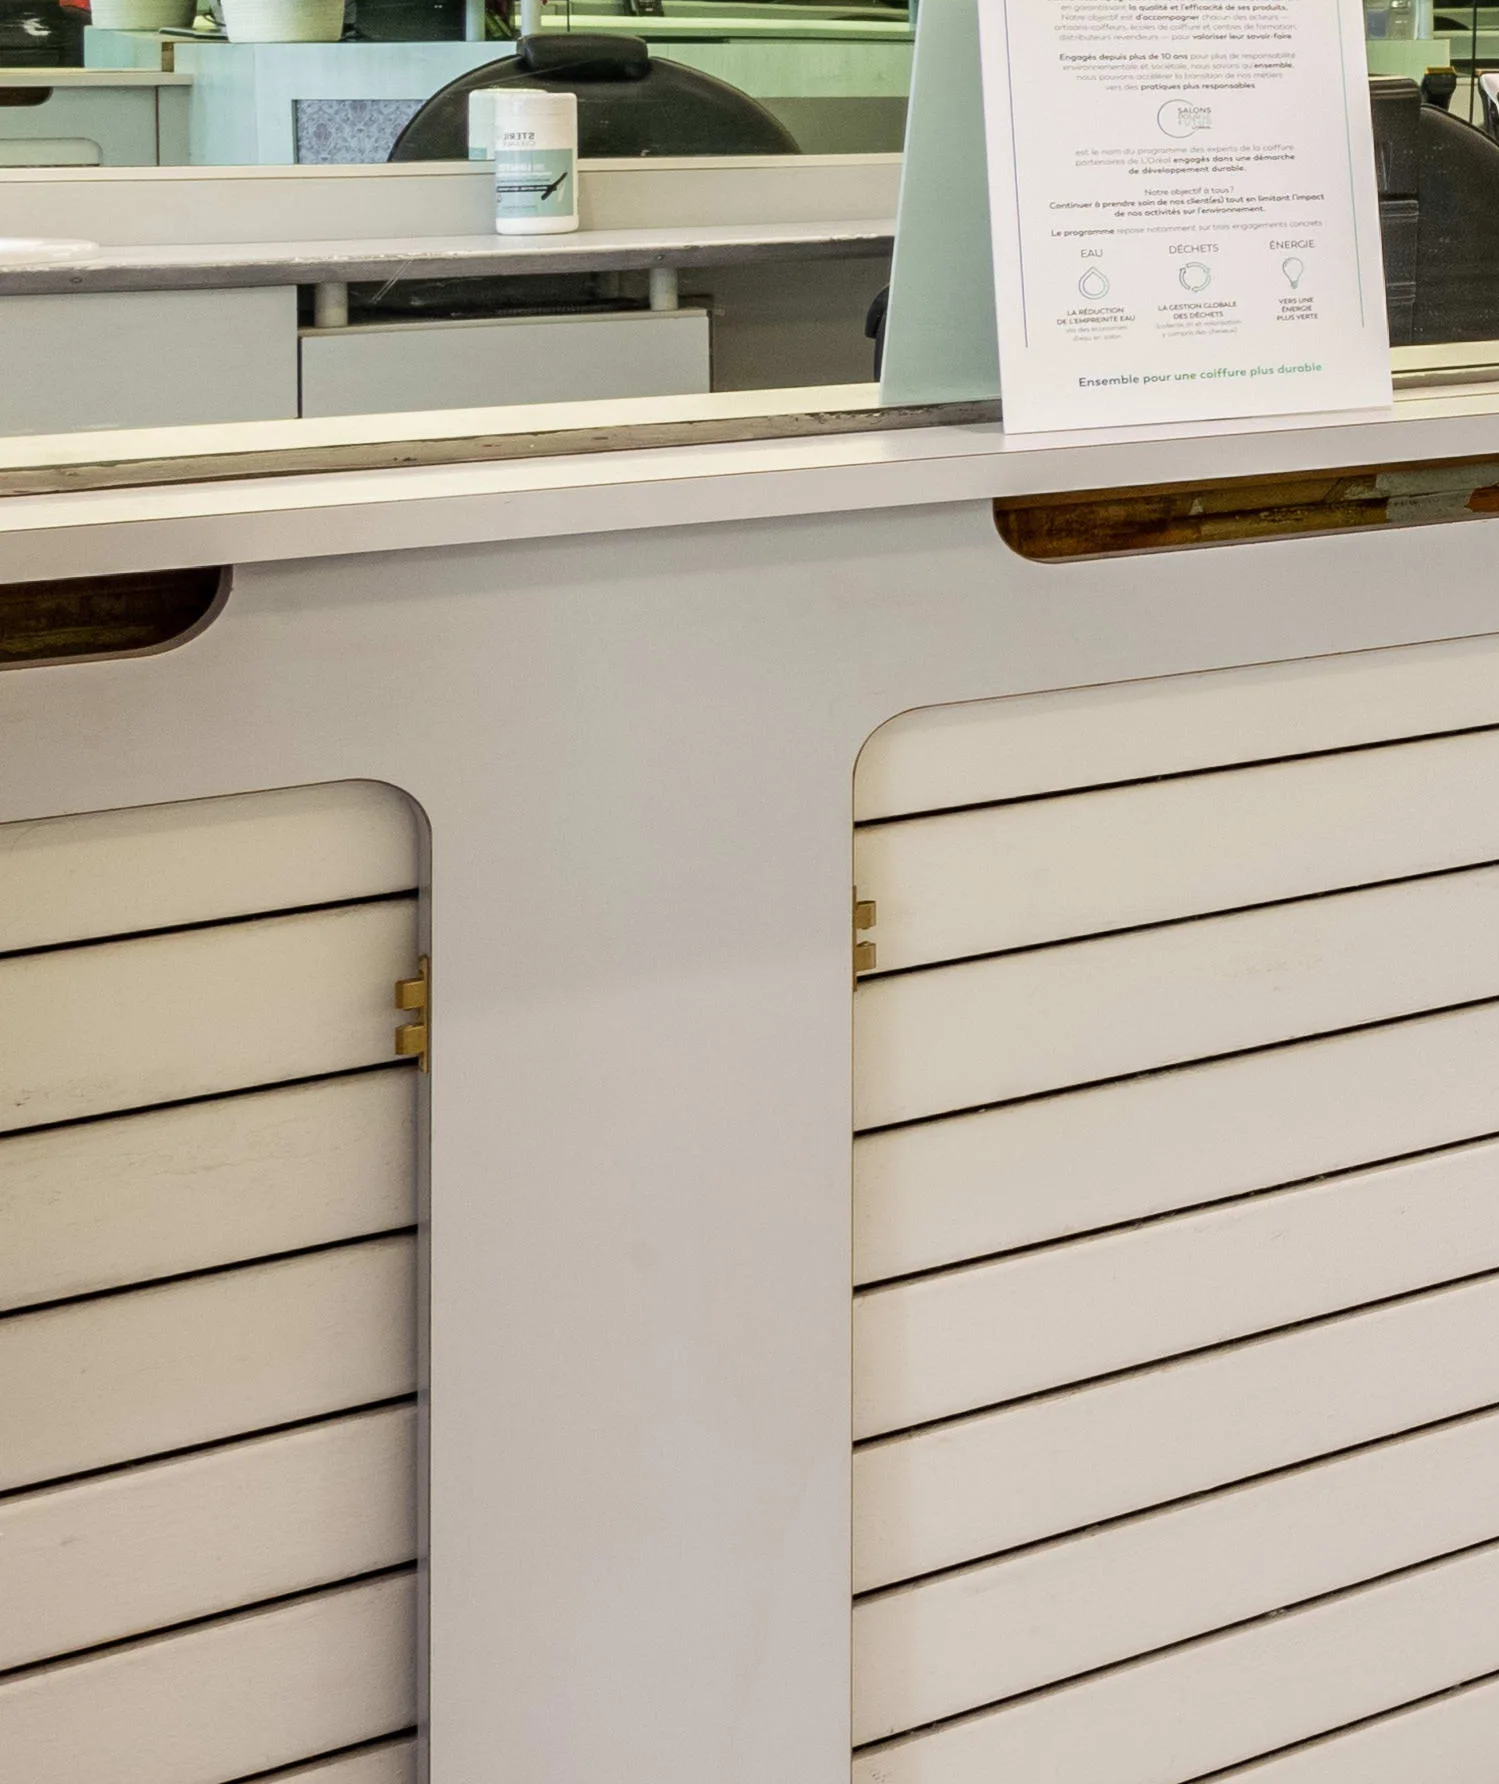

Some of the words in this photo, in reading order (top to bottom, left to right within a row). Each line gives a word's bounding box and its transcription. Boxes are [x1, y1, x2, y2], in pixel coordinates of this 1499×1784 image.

[1177, 106, 1213, 114] SALONS
[1169, 243, 1220, 255] DÉCHETS
[1269, 238, 1315, 250] ÉNERGIE
[1081, 249, 1103, 258] EAU
[1078, 374, 1140, 386] Ensemble
[1142, 374, 1171, 384] pour
[1198, 368, 1247, 379] coiffure
[1249, 366, 1274, 378] plus
[1276, 363, 1322, 374] durable
